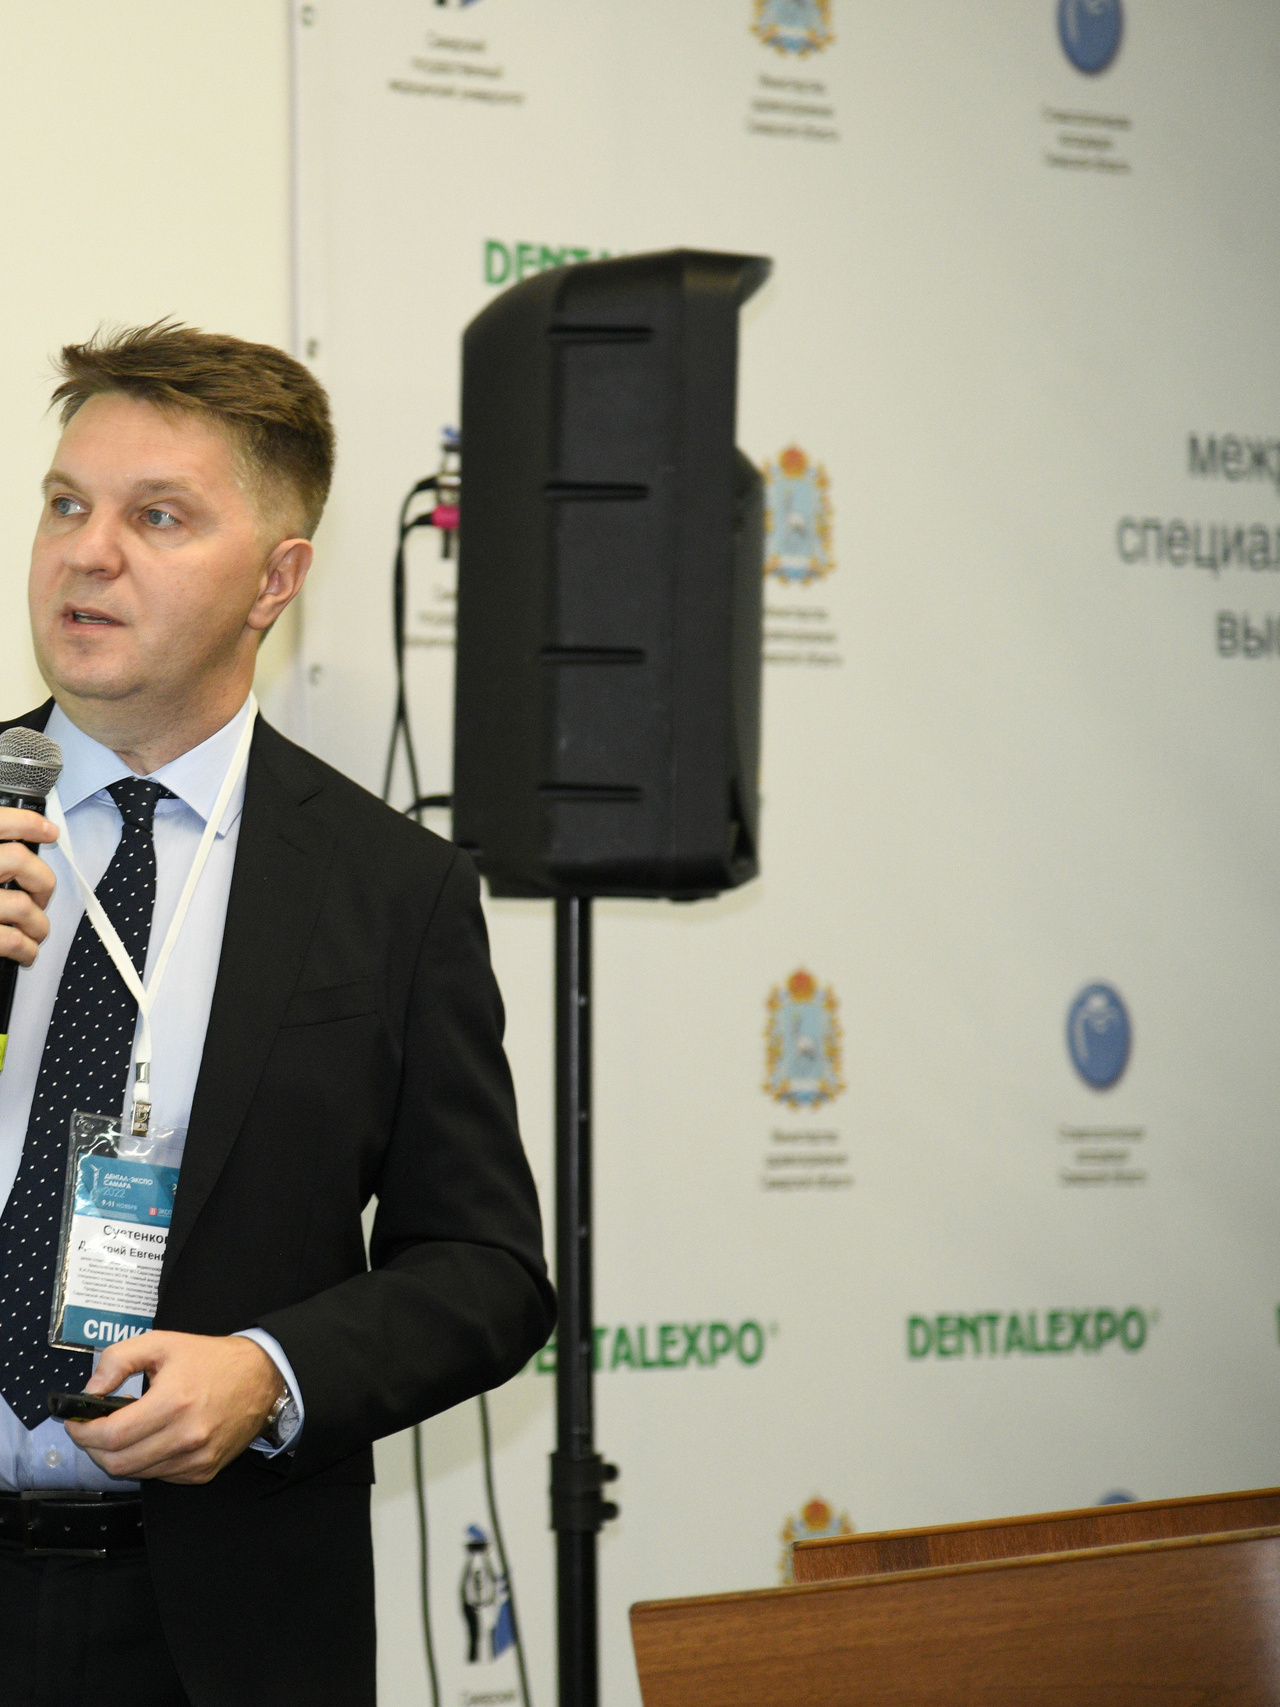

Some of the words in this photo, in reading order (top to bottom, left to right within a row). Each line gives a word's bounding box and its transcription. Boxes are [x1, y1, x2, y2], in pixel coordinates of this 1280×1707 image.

[1188, 433, 1280, 496] меж
[1118, 517, 1280, 579] специа
[1218, 611, 1280, 659] вы
[102, 1186, 126, 1199] 2022
[103, 1180, 132, 1190] САМАРА
[83, 1319, 153, 1343] СПИК
[907, 1305, 1148, 1359] DENTALEXPO
